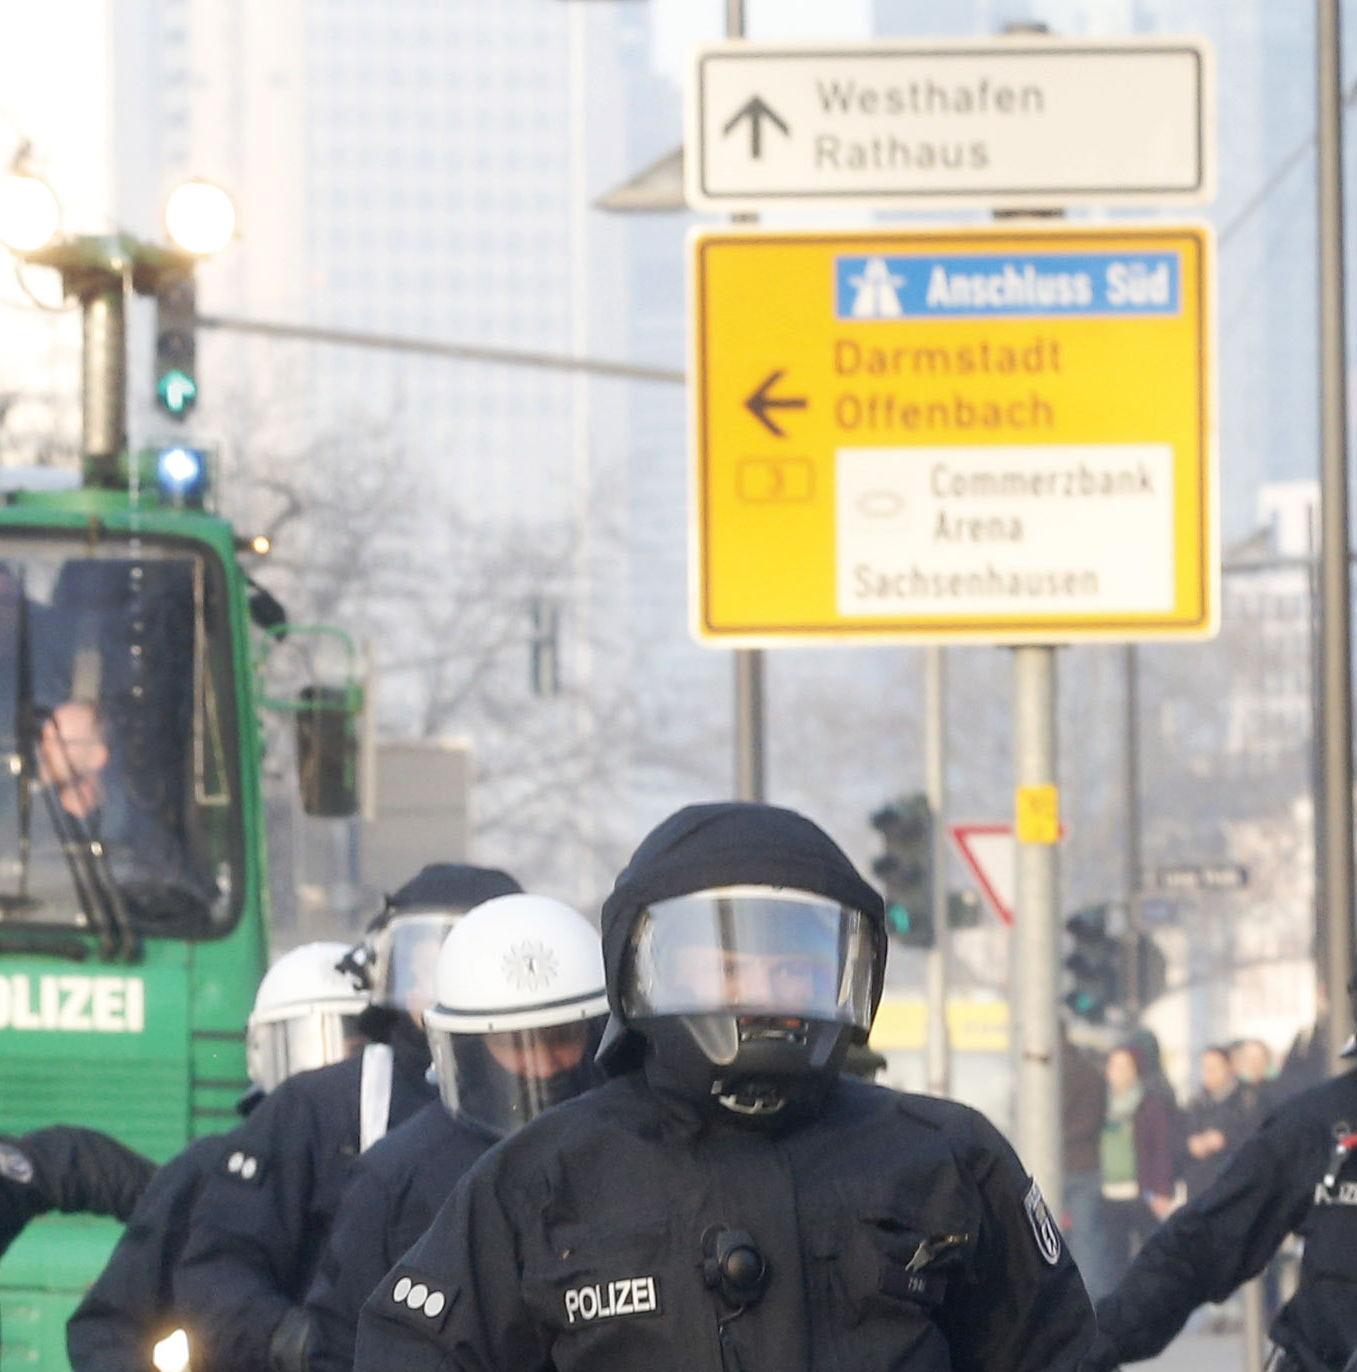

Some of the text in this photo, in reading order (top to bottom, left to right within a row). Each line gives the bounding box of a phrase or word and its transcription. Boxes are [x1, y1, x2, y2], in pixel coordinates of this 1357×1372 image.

[815, 78, 1046, 116] Westhafen
[814, 133, 991, 170] Rathaus
[926, 260, 1170, 309] Anschluss Süd
[833, 336, 1064, 377] Darmstadt
[833, 392, 1056, 433] Offenbach
[929, 461, 1155, 499] Commerzbank
[932, 512, 1025, 546] Arena
[853, 563, 1100, 601] Sachsenhausen
[565, 1276, 657, 1325] POLIZEI
